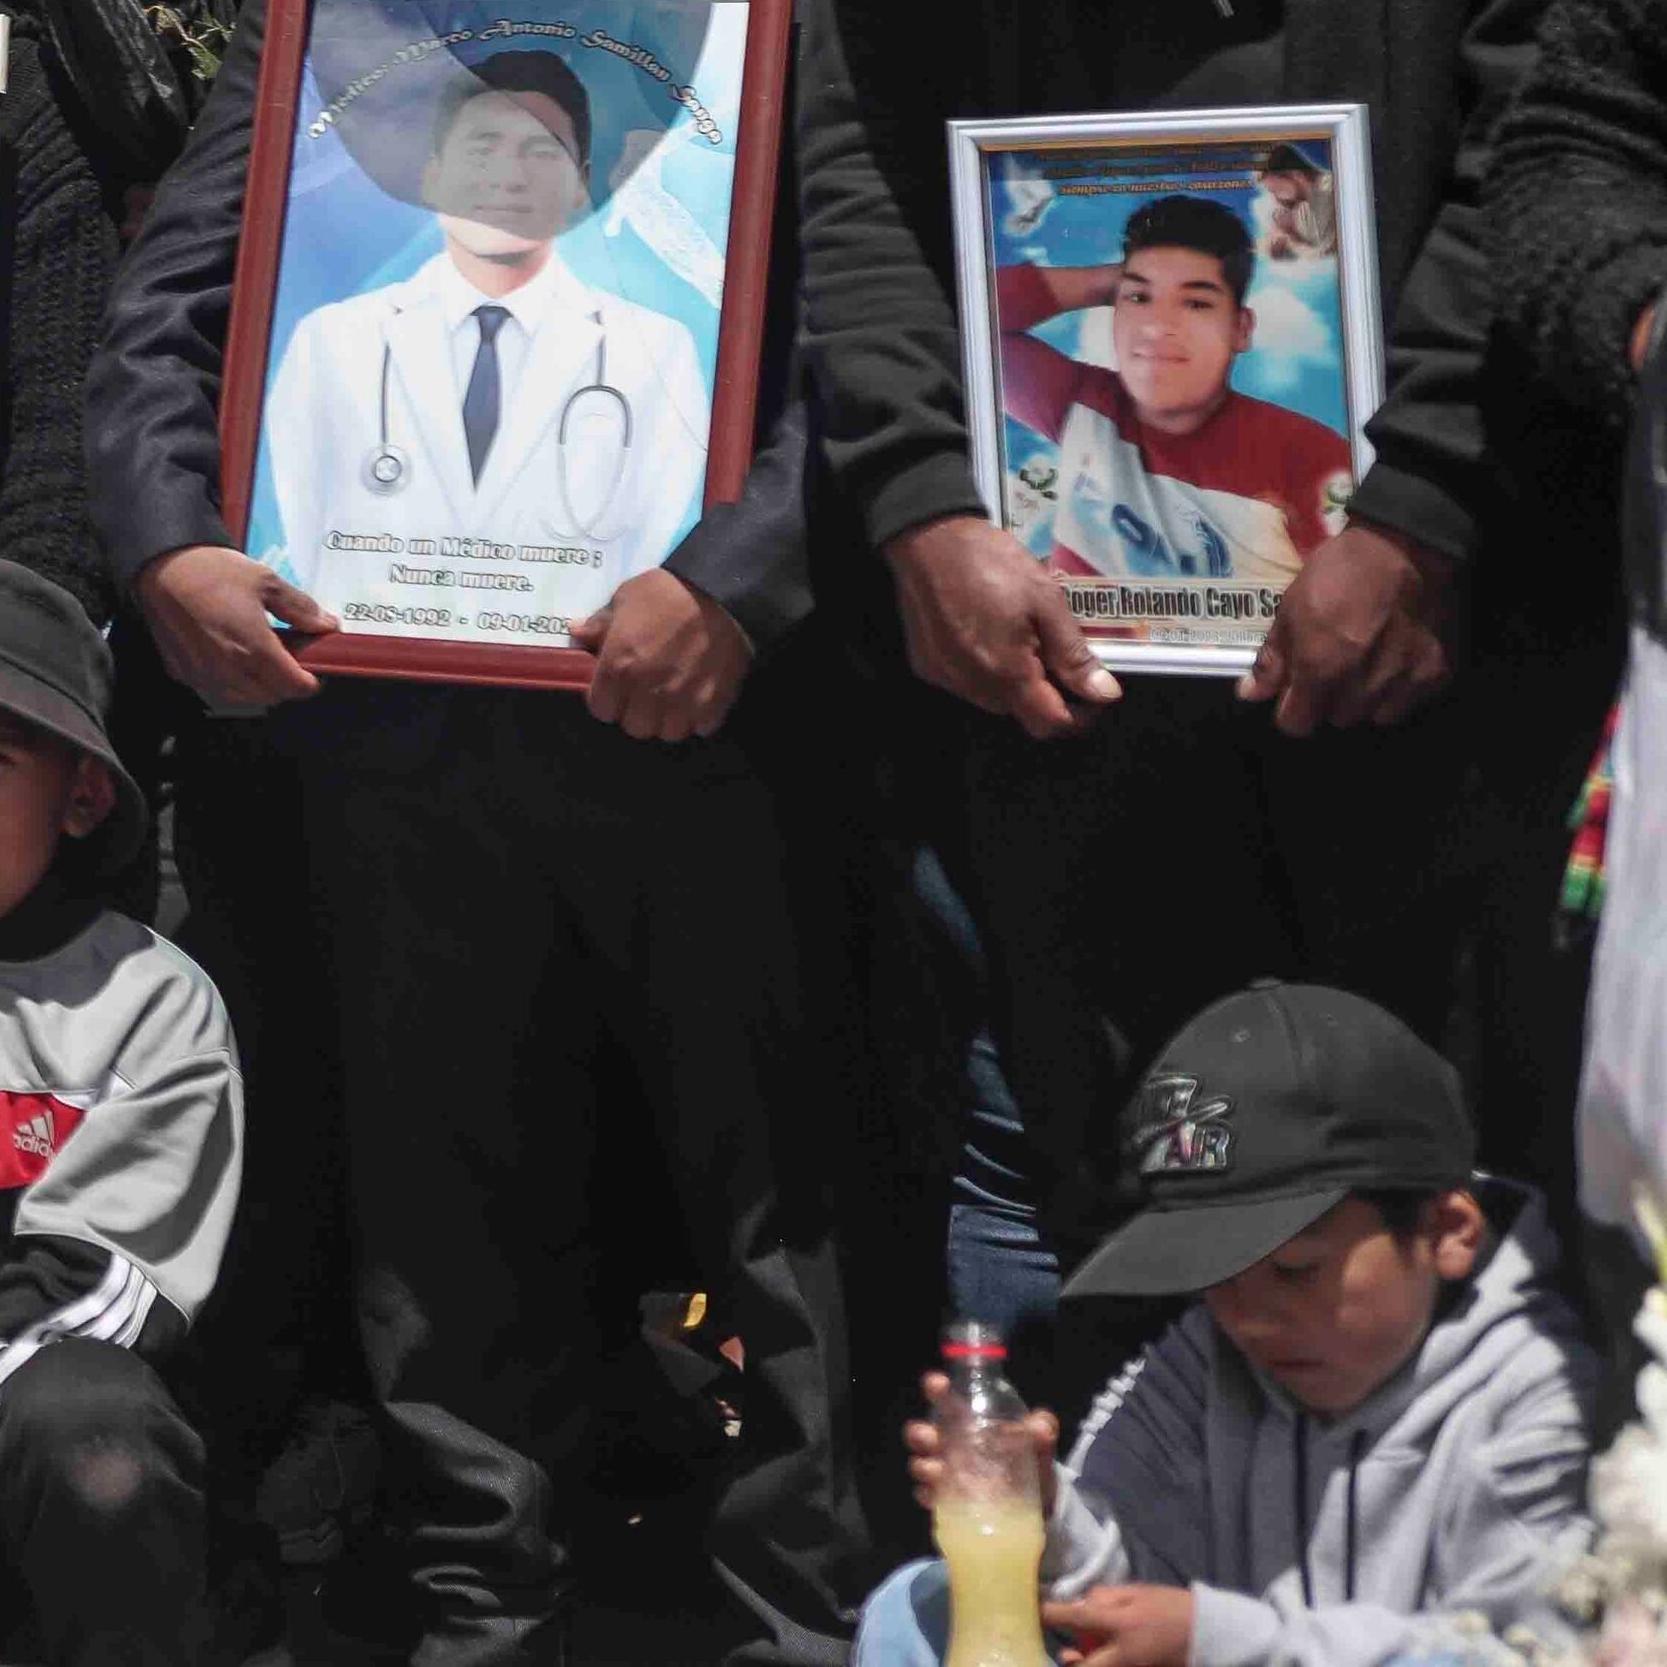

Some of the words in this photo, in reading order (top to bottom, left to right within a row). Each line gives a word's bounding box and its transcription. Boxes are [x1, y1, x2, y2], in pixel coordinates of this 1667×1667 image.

[325, 529, 405, 553] Cuando
[409, 538, 436, 555] un
[441, 536, 516, 560] Médico
[518, 544, 590, 565] muere
[389, 563, 456, 586] Nunca
[459, 570, 535, 592] muere.
[1120, 586, 1202, 618] Rolando
[1205, 587, 1255, 619] Cayo
[477, 611, 572, 635] 09-01-202
[11, 1134, 56, 1166] adid
